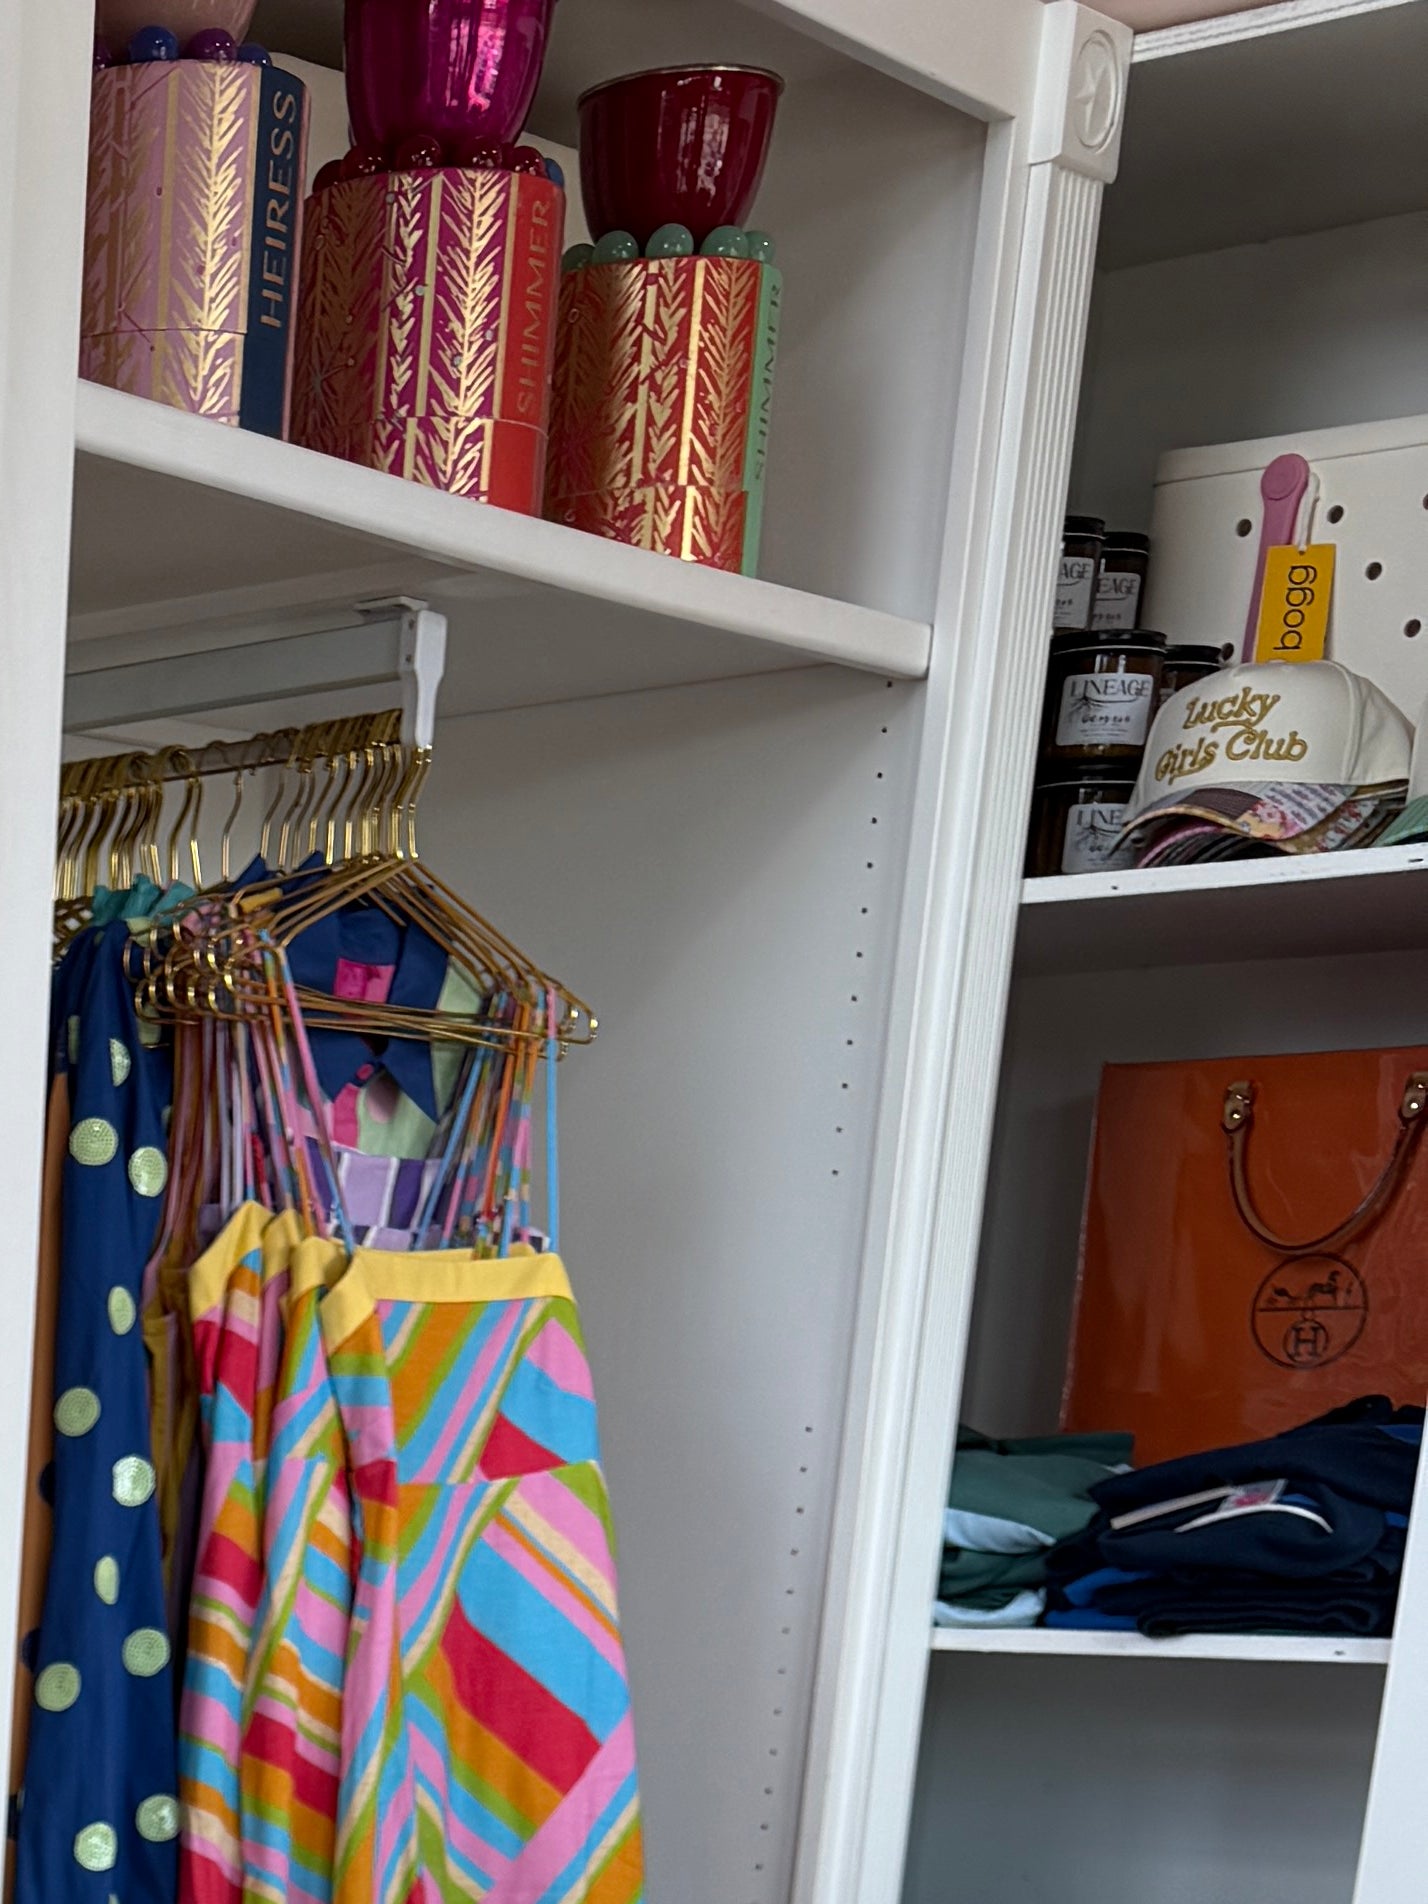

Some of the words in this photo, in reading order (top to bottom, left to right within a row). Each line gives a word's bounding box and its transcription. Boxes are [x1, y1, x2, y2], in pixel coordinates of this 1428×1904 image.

[259, 90, 298, 329] HEIRESS
[516, 199, 551, 415] SHIMMER
[1273, 563, 1317, 652] bogg
[1070, 678, 1152, 698] LINEAGE
[1182, 686, 1281, 733] Lucky
[1154, 736, 1220, 786] Girls
[1225, 728, 1309, 762] Club
